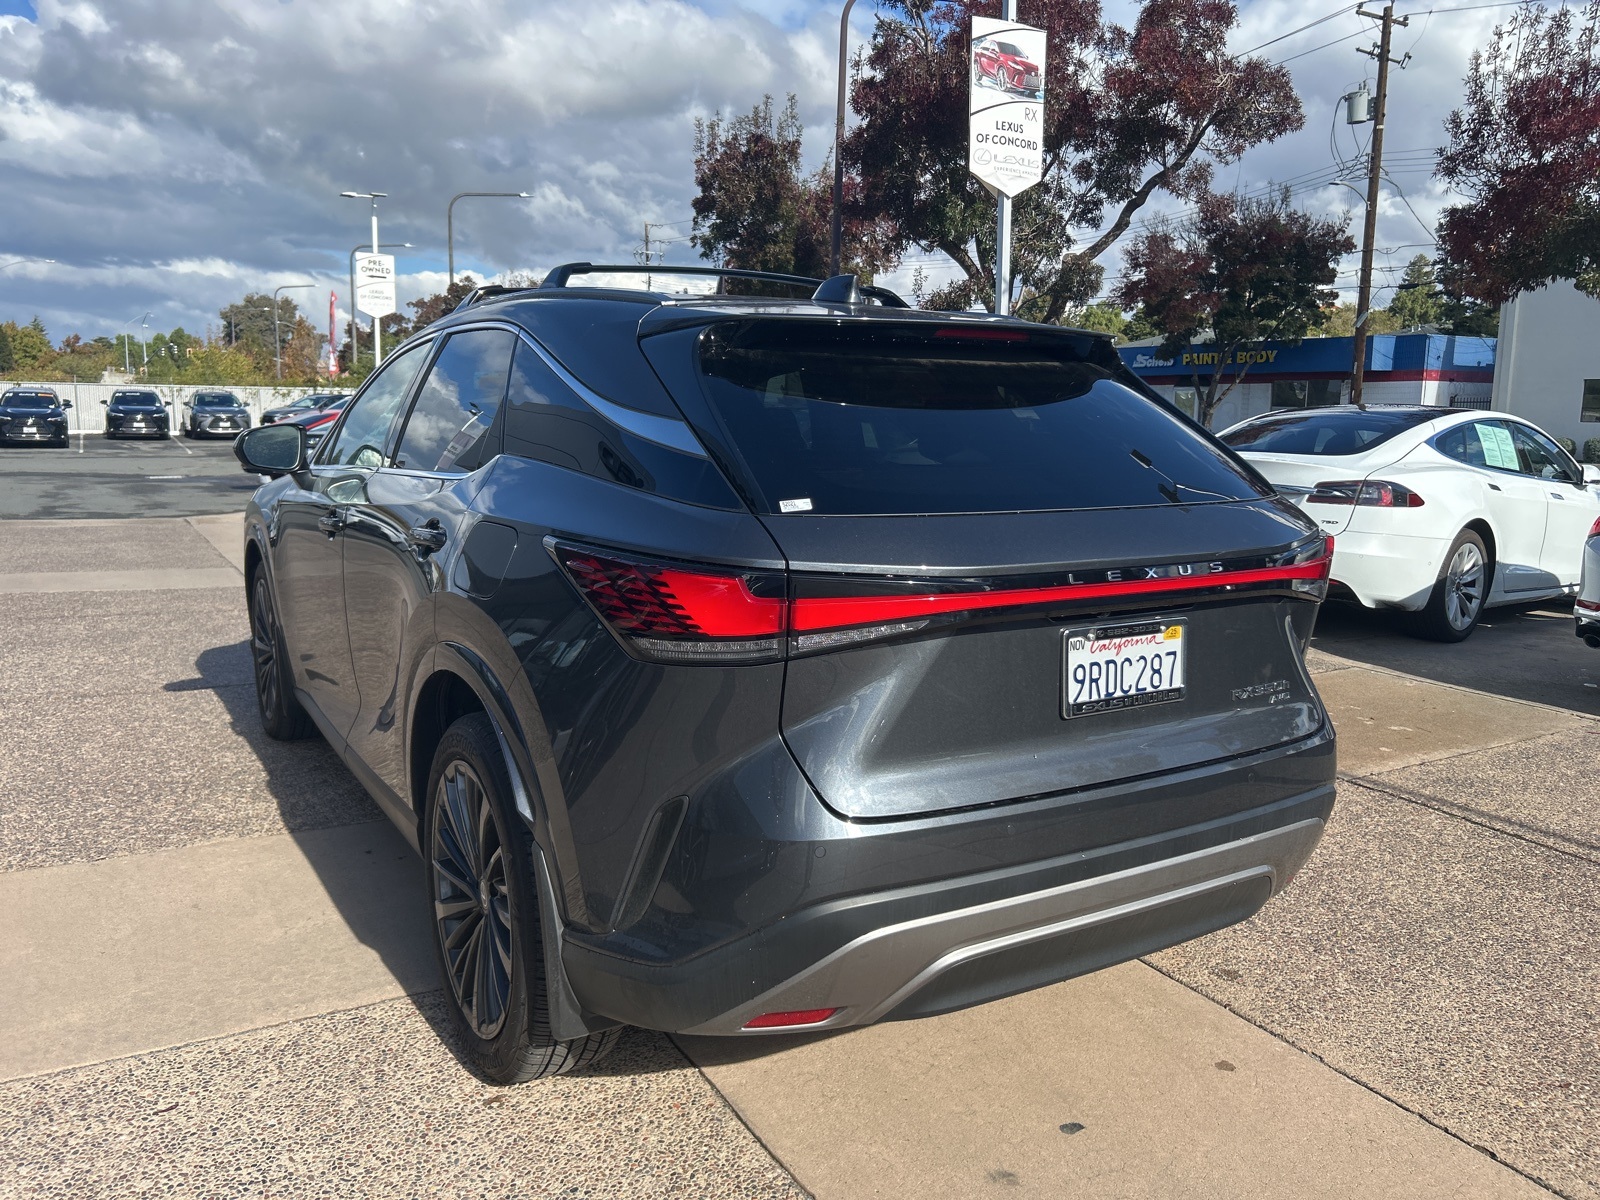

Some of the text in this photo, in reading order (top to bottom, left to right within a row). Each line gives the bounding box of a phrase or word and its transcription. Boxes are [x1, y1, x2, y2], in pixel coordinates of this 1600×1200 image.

[1024, 107, 1038, 122] RX
[996, 120, 1024, 134] LEXUS
[976, 133, 1038, 151] OF CONCORD
[993, 153, 1040, 169] LEXUS
[361, 266, 391, 274] OWNED
[368, 259, 385, 267] PRE-
[1182, 352, 1219, 366] PAINT
[1236, 350, 1279, 364] BODY
[1068, 561, 1224, 585] LEXUS
[1069, 640, 1086, 652] NOV
[1089, 634, 1164, 656] California
[1072, 650, 1178, 703] 9RDC287
[1073, 699, 1124, 715] LEXUS
